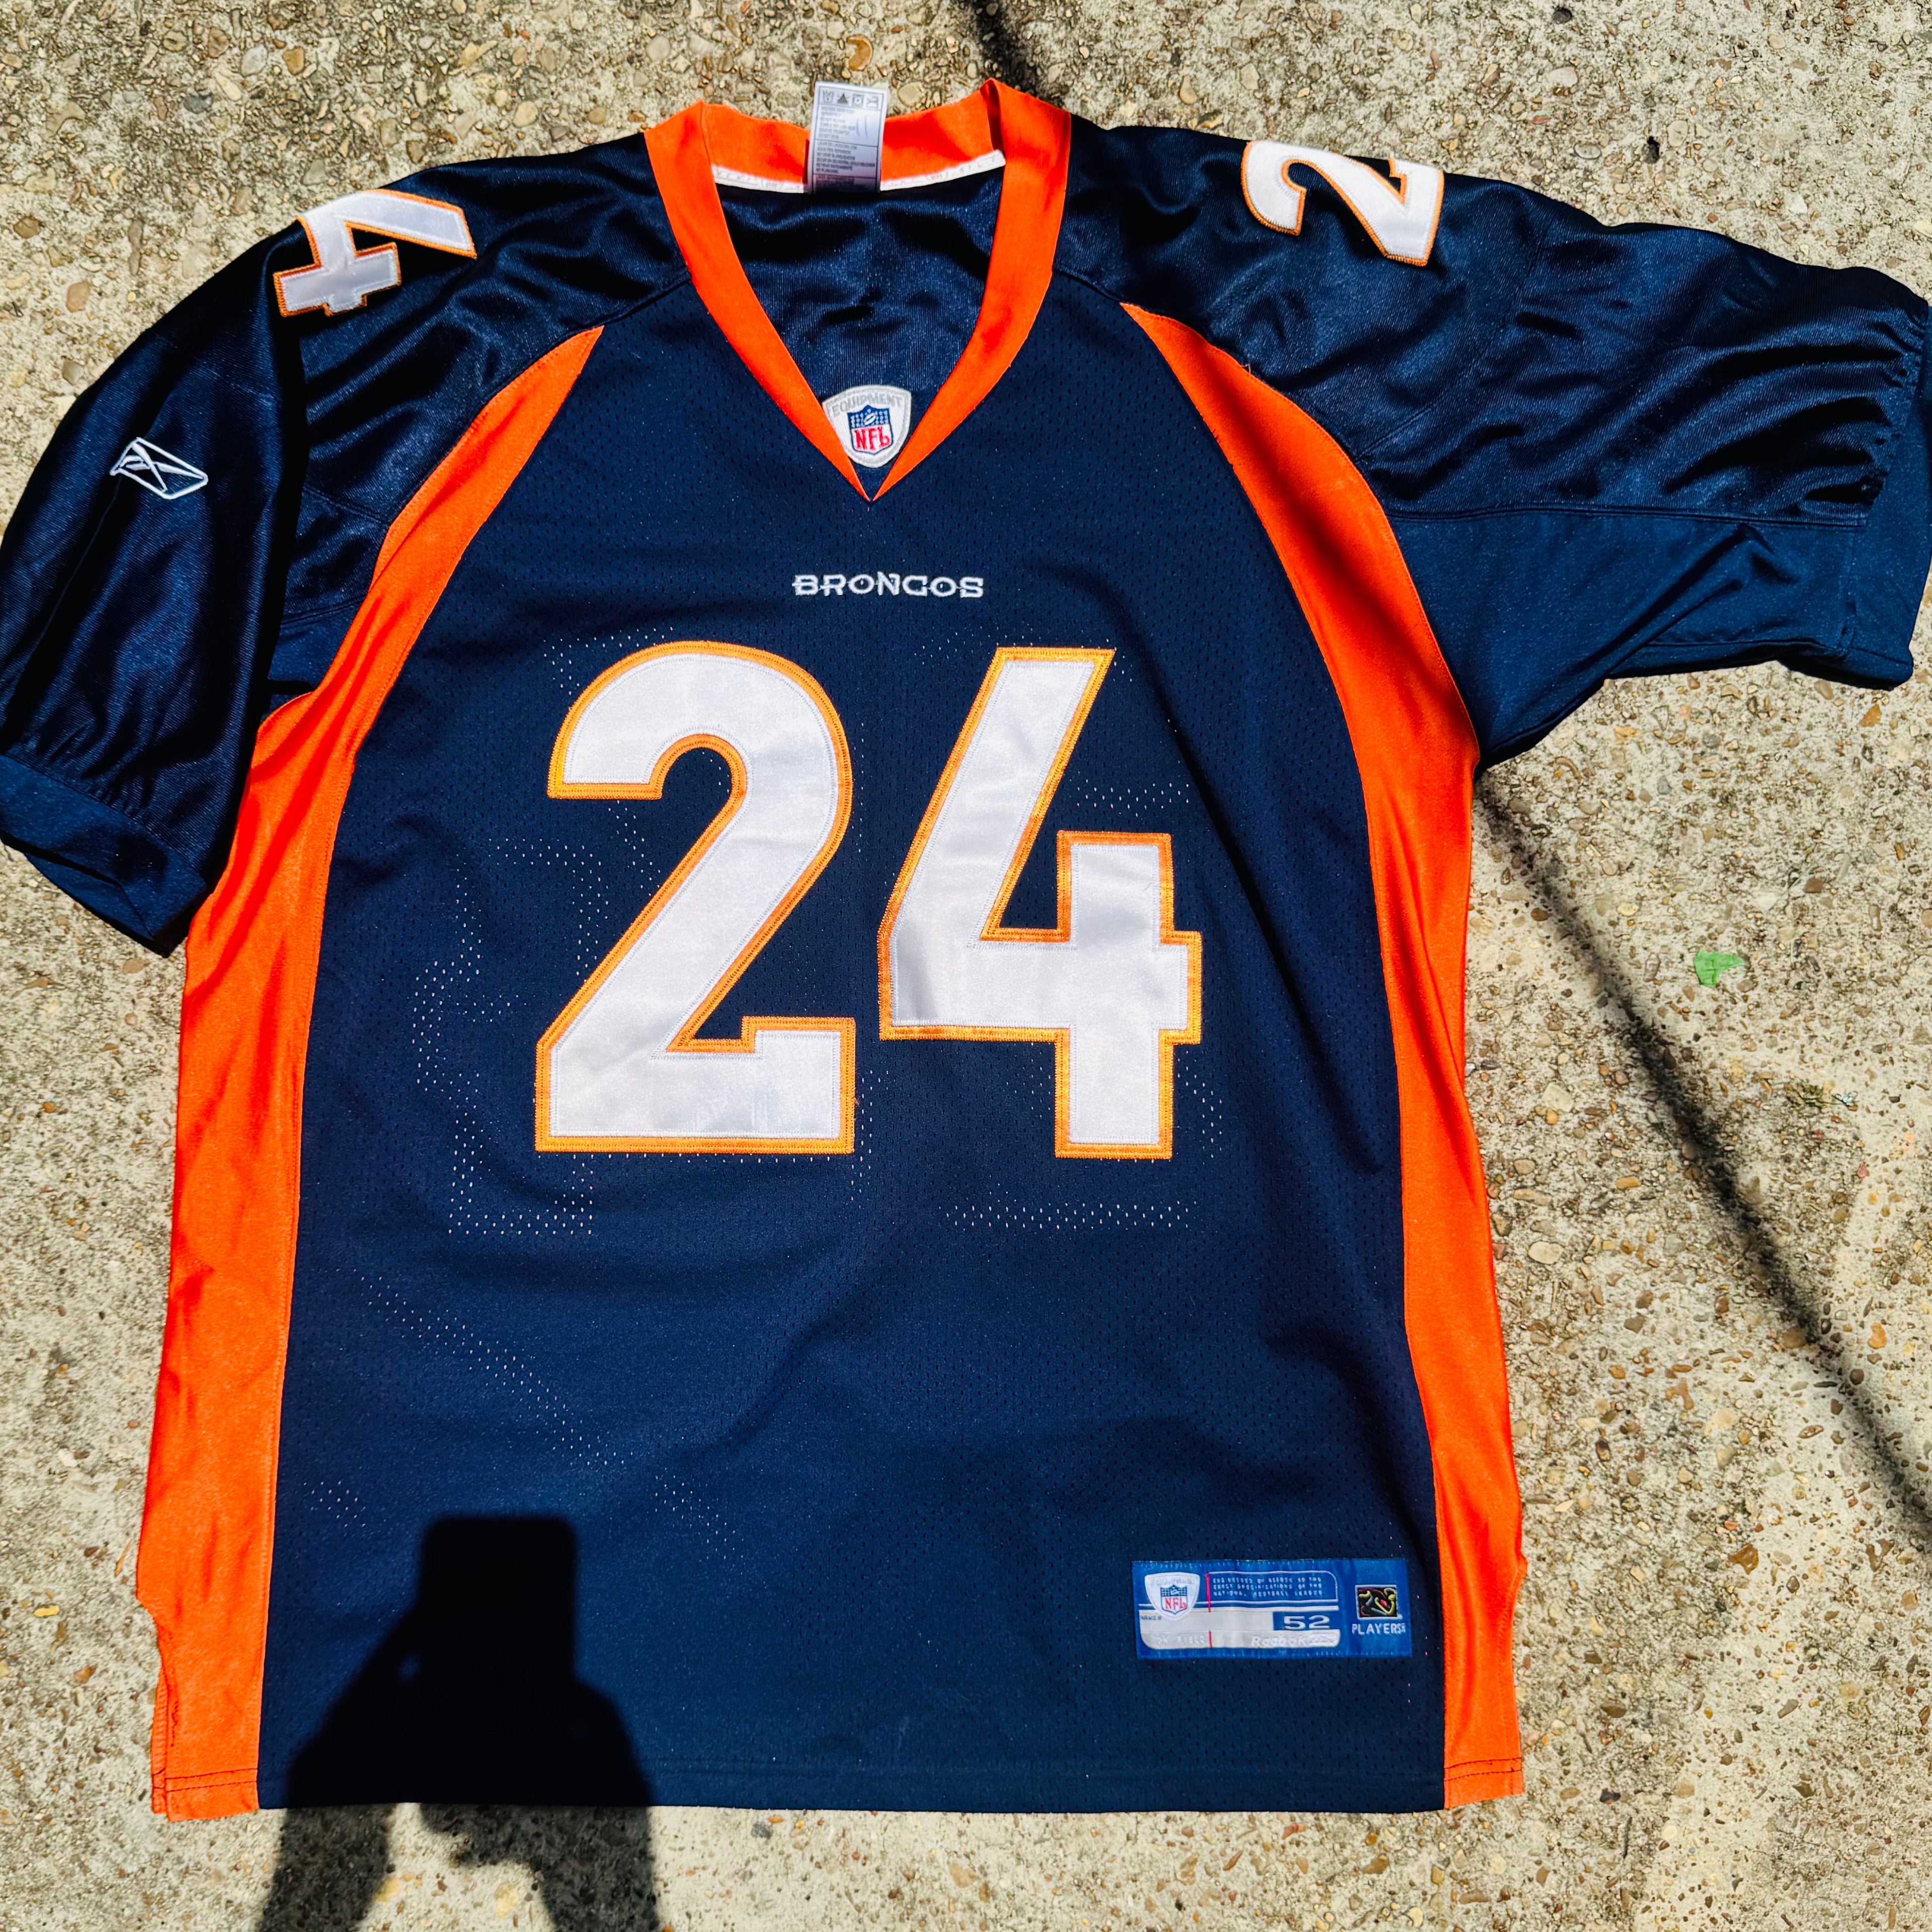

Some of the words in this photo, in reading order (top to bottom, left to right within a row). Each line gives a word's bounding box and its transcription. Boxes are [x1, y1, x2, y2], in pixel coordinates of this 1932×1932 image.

[1241, 140, 1444, 267] 2
[832, 393, 903, 418] EQUIPMENT
[854, 427, 891, 451] NFL
[792, 571, 984, 598] BRONCOS
[534, 640, 1202, 1160] 24
[1164, 1597, 1188, 1610] NFL
[1283, 1615, 1330, 1630] 52
[1351, 1623, 1402, 1635] PLAYERS
[1251, 1635, 1308, 1647] Reebok
